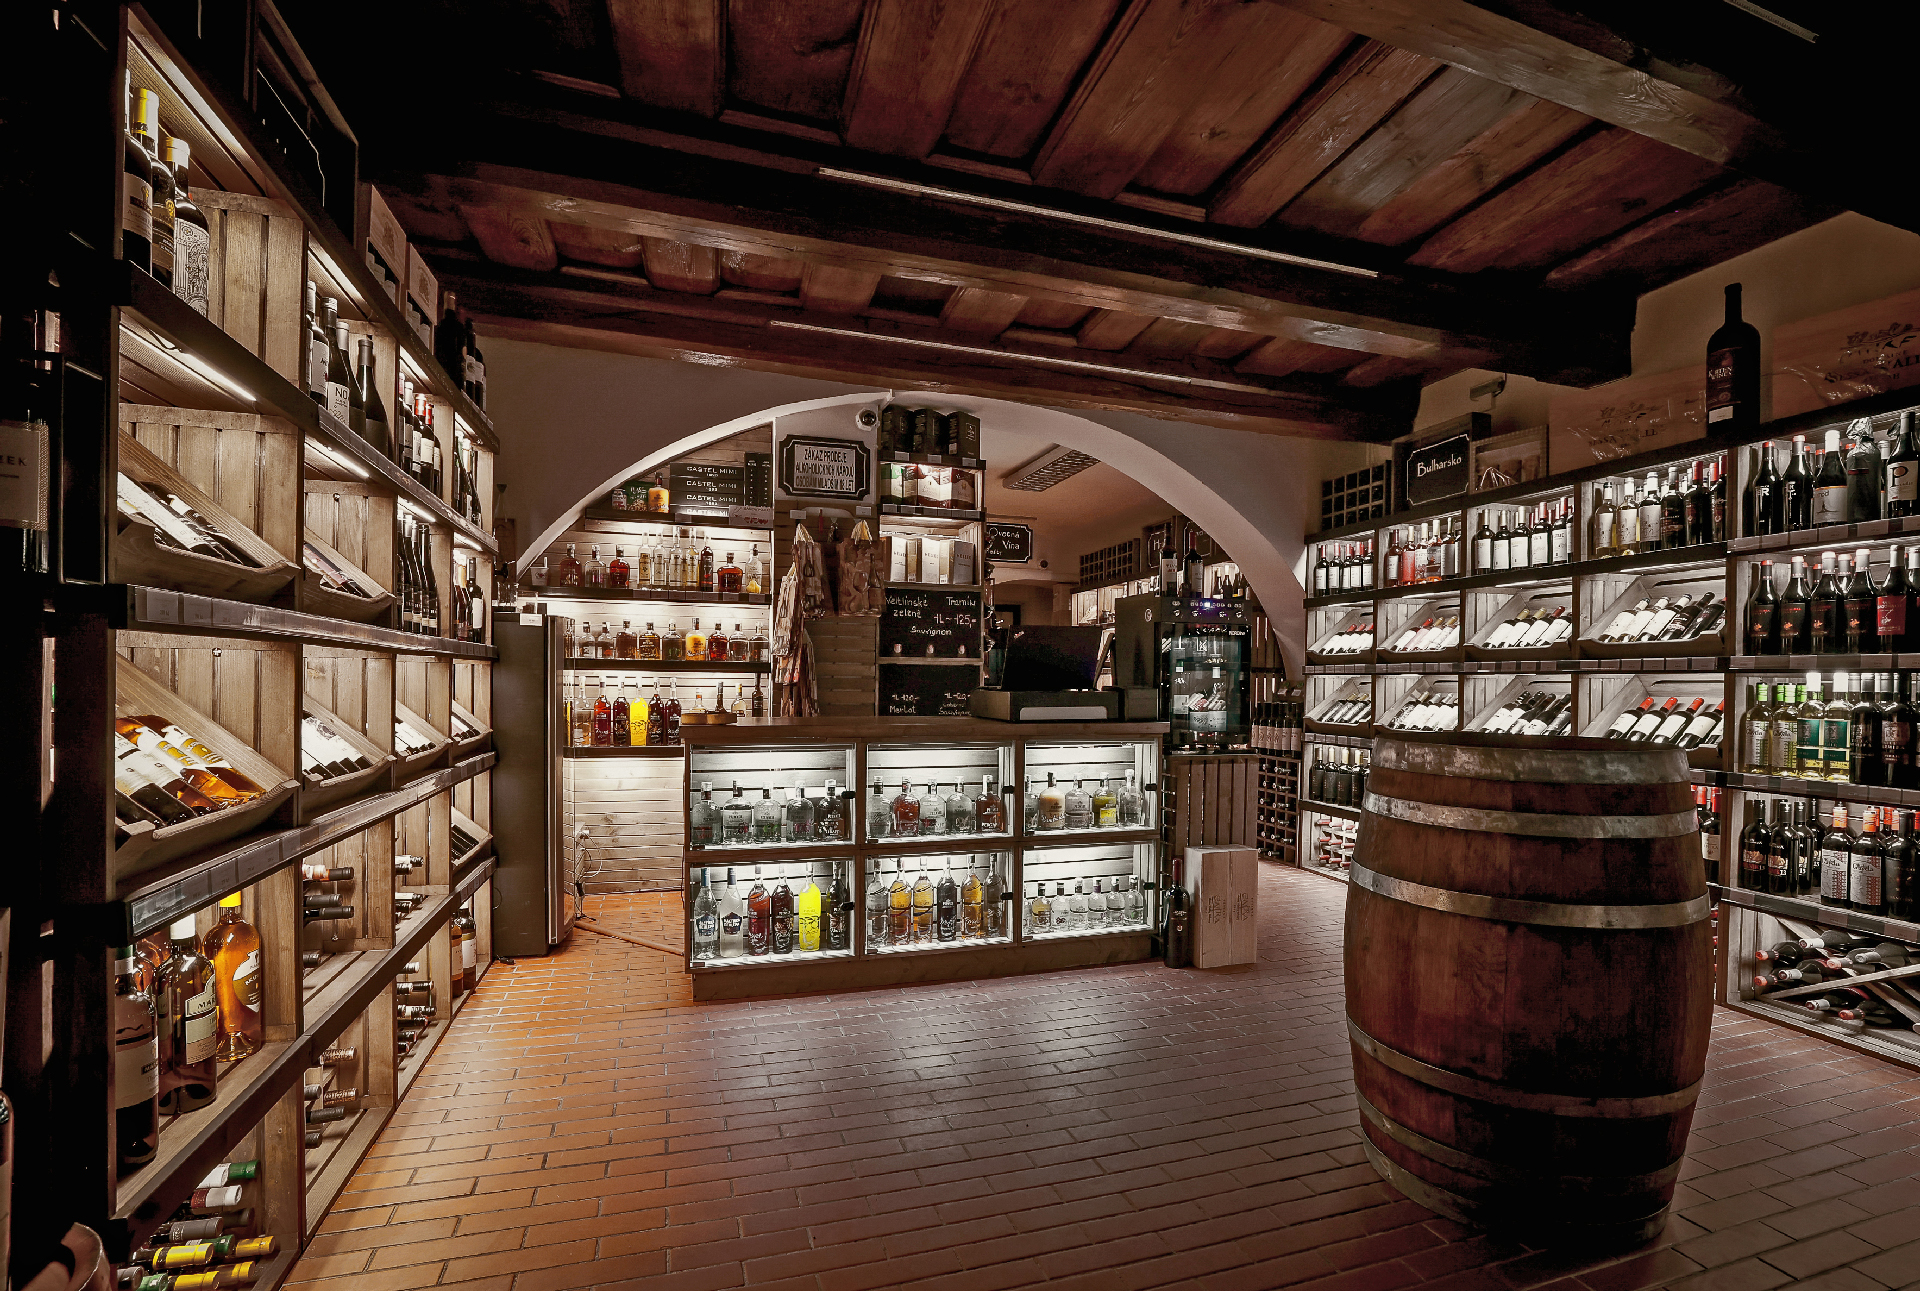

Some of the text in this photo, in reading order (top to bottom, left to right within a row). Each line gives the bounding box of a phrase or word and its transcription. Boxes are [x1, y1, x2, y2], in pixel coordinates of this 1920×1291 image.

[804, 447, 847, 464] ZÁKAZ PRODEJE
[686, 466, 718, 474] CASTEL
[1417, 454, 1462, 478] Bulharsko
[686, 480, 718, 488] CASTEL
[686, 494, 718, 502] CASTEL
[686, 508, 718, 516] CASTEL
[989, 526, 1020, 539] Ovocná
[910, 625, 952, 637] Sauvignon
[889, 705, 917, 714] Merlot
